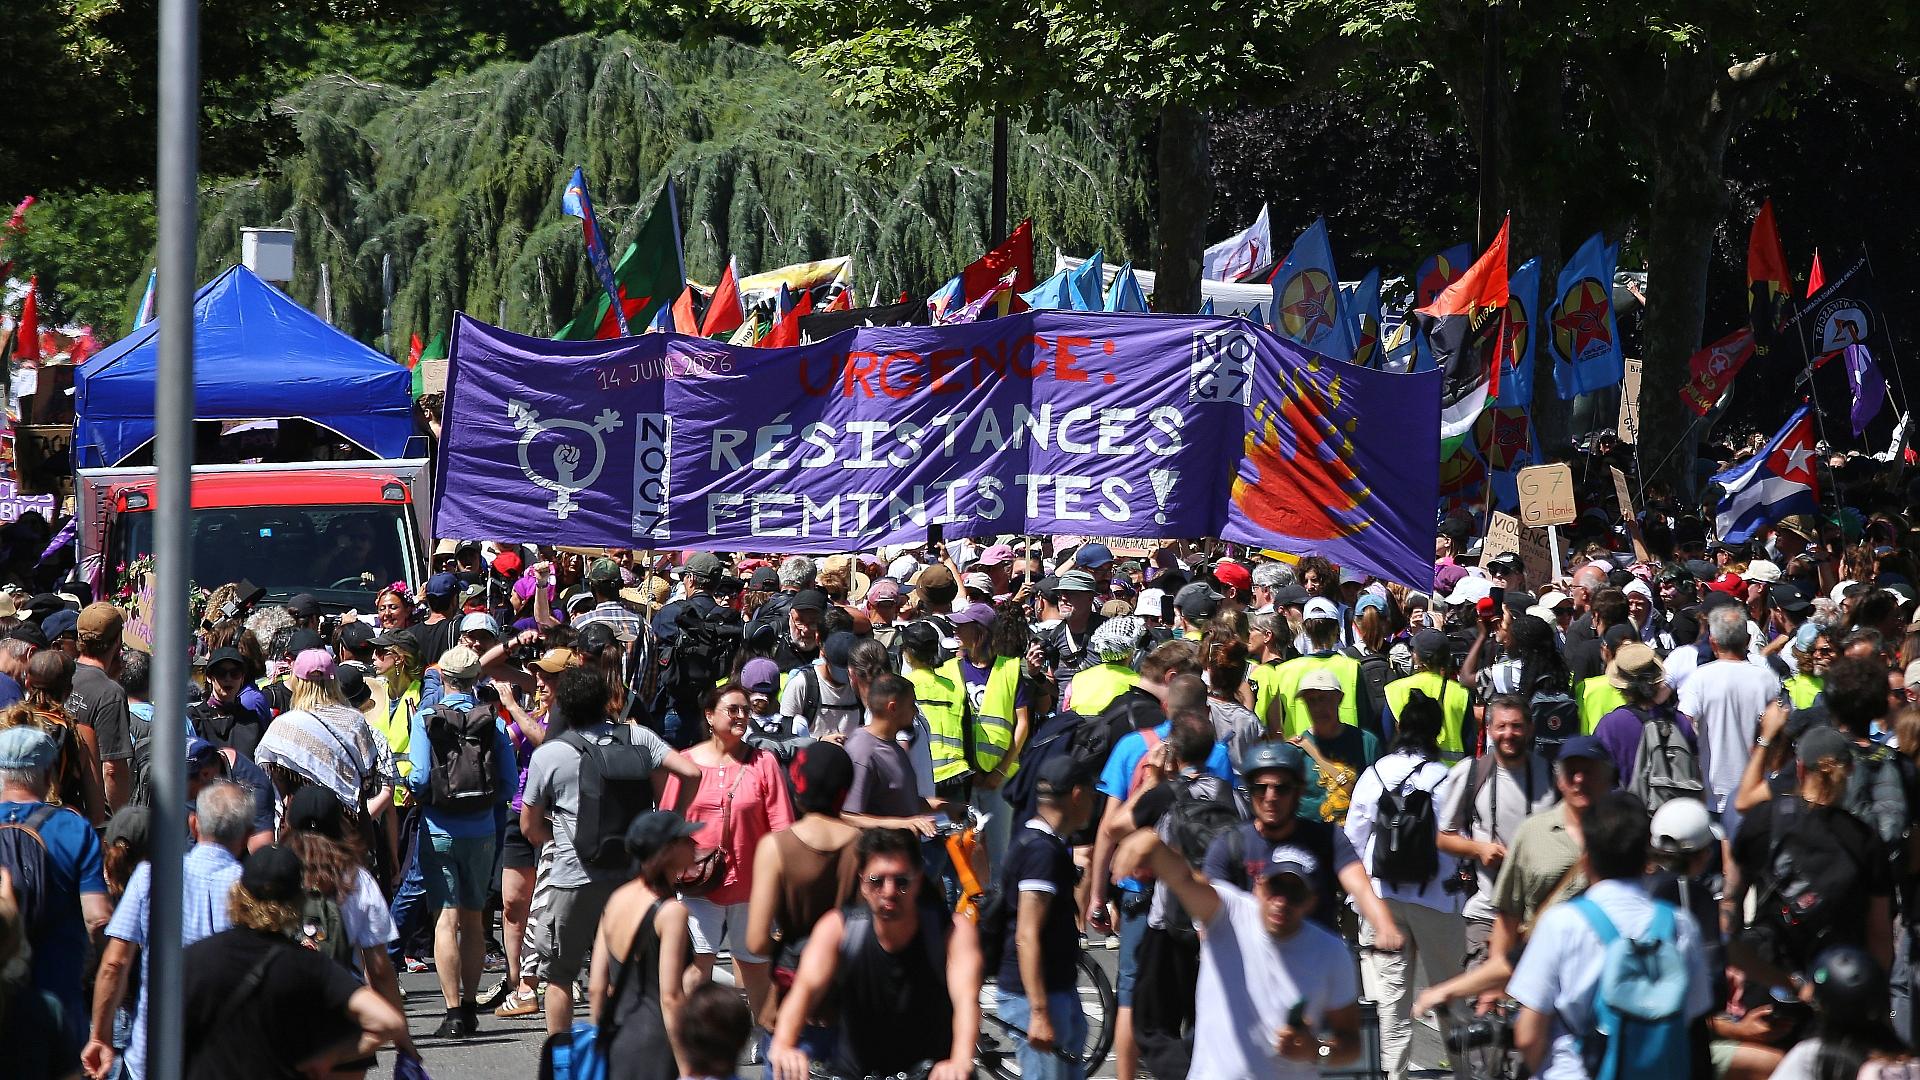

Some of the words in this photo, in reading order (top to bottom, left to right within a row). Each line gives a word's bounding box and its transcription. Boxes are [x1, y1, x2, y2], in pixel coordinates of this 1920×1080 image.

[1195, 333, 1252, 364] NO
[598, 367, 621, 391] 14
[629, 356, 675, 384] JUIN
[681, 354, 733, 376] 2026
[800, 335, 1117, 399] URGENCE:
[1195, 368, 1251, 400] G7
[709, 403, 1185, 472] RÉSISTANCES
[1524, 501, 1541, 522] G
